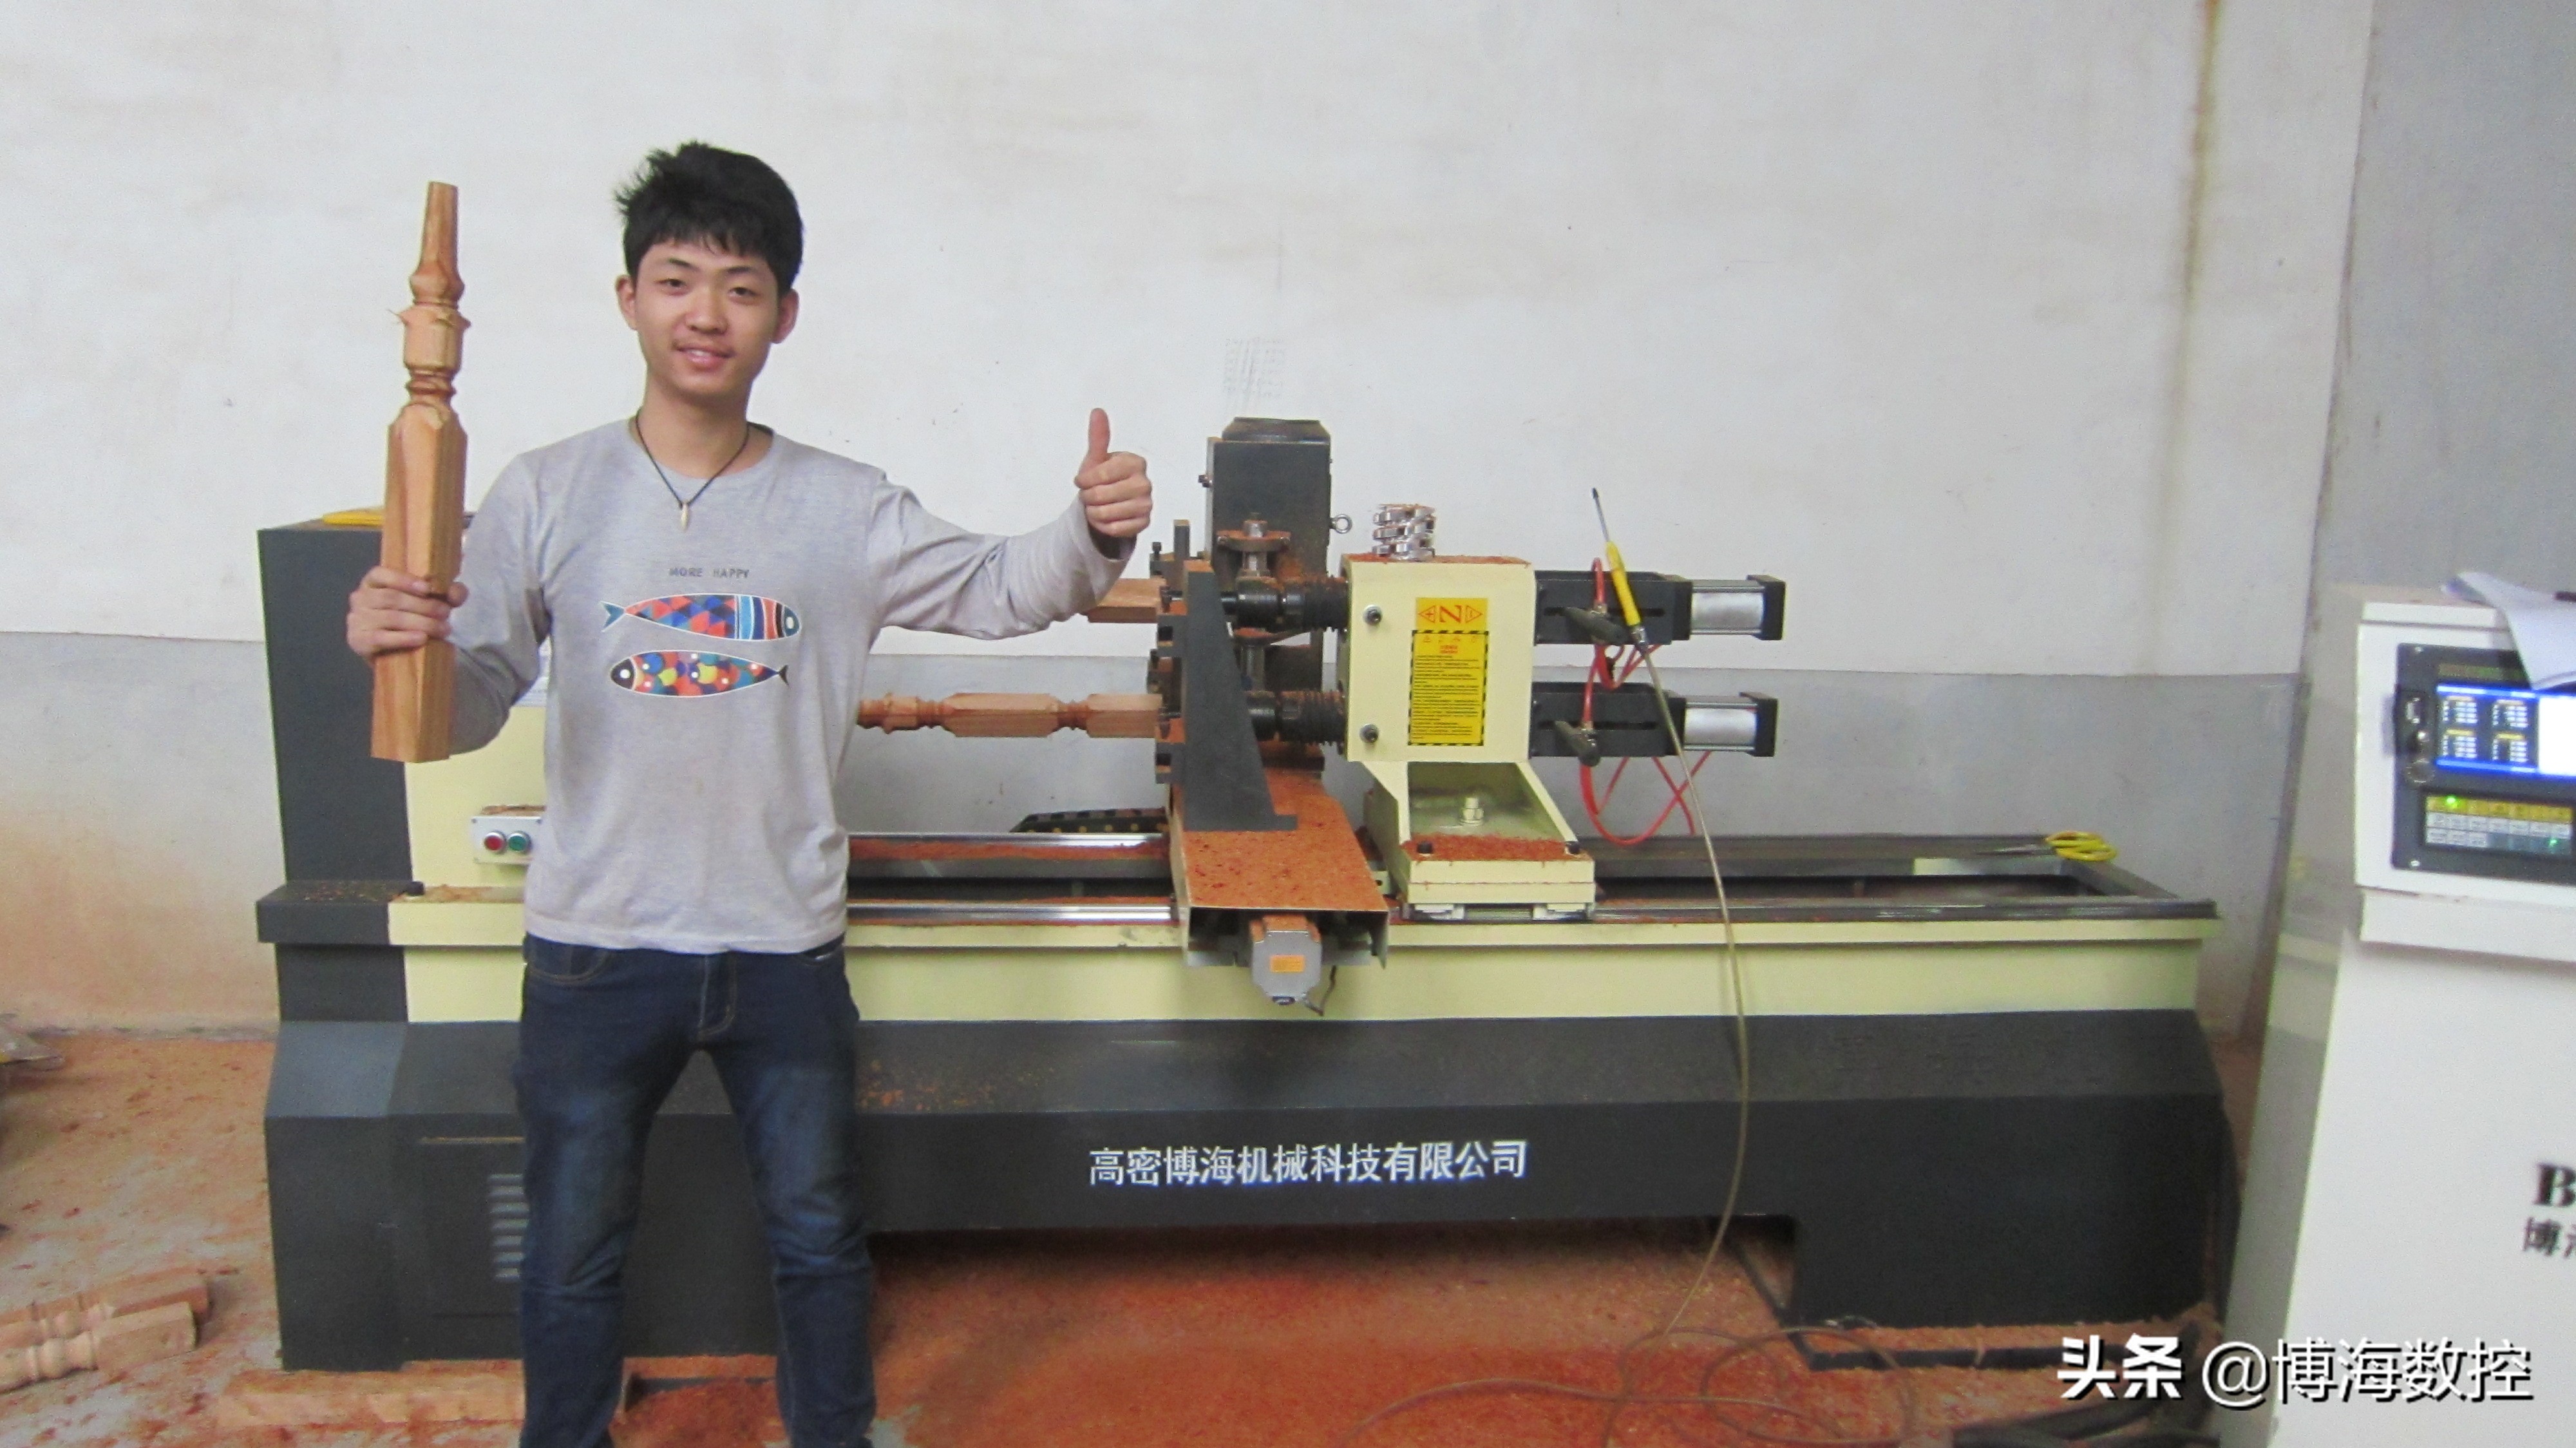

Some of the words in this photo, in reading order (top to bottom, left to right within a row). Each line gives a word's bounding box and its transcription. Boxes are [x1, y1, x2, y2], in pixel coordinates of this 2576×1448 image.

[669, 567, 703, 577] MORE
[713, 567, 750, 578] HAPPY
[1089, 1139, 1527, 1186] 高密博海机械科技有限公司
